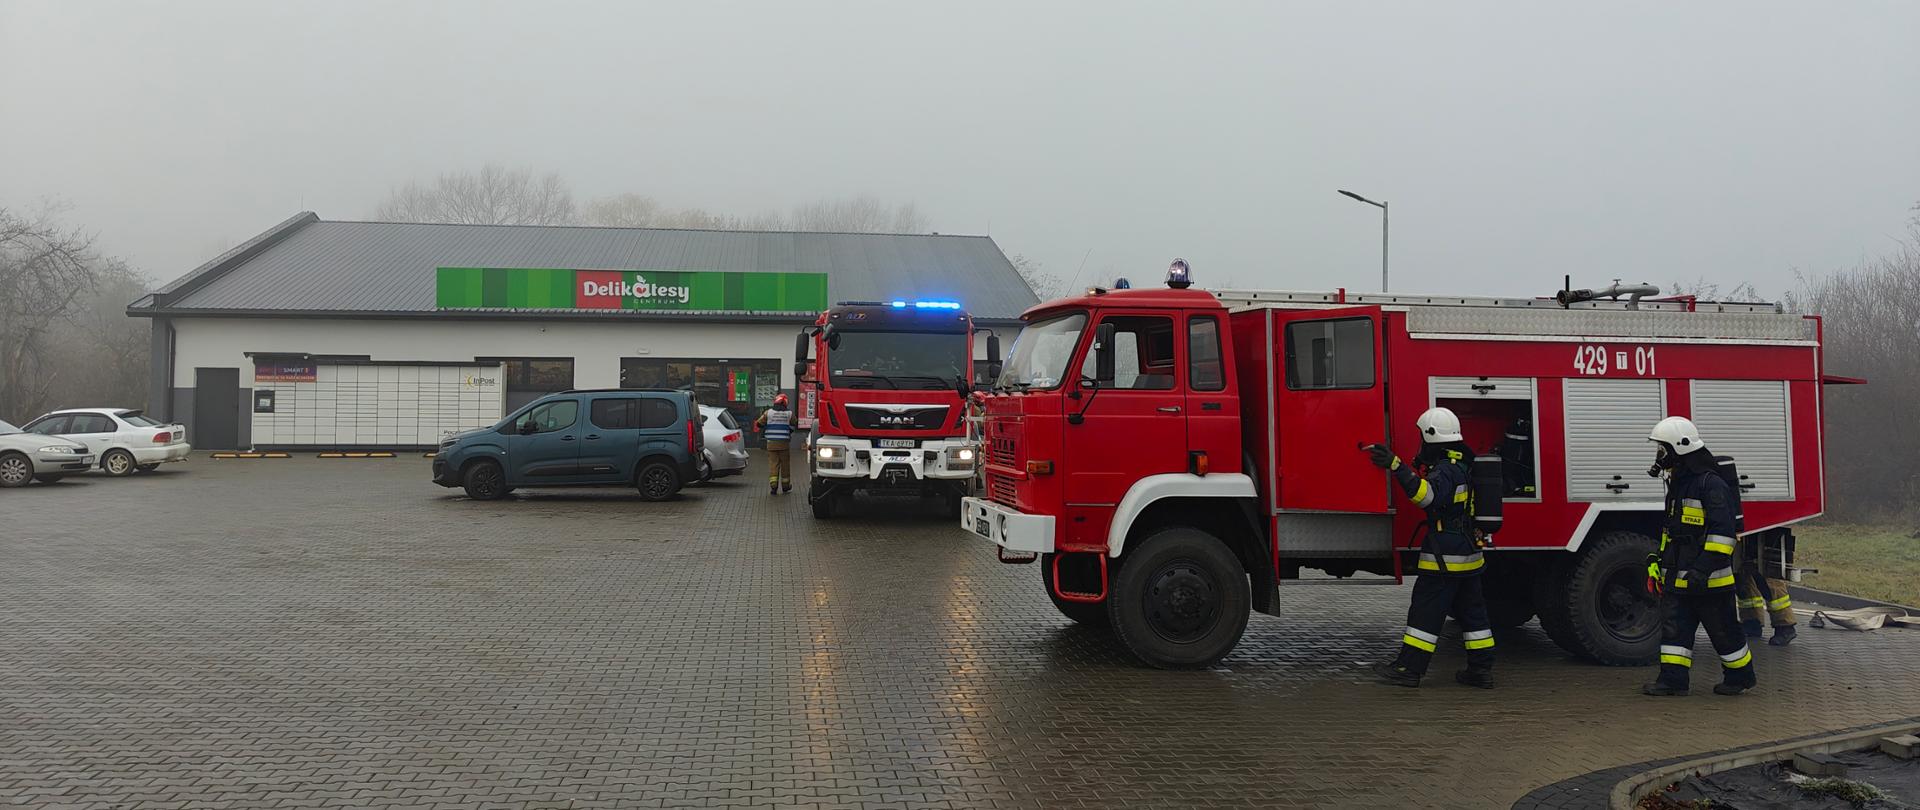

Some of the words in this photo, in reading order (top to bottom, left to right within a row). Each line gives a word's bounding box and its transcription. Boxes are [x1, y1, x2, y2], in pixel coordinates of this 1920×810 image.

[583, 279, 689, 303] Delikatesy
[1573, 345, 1607, 375] 429
[1635, 346, 1656, 375] 01
[473, 377, 495, 385] InPost
[880, 416, 915, 424] MAN
